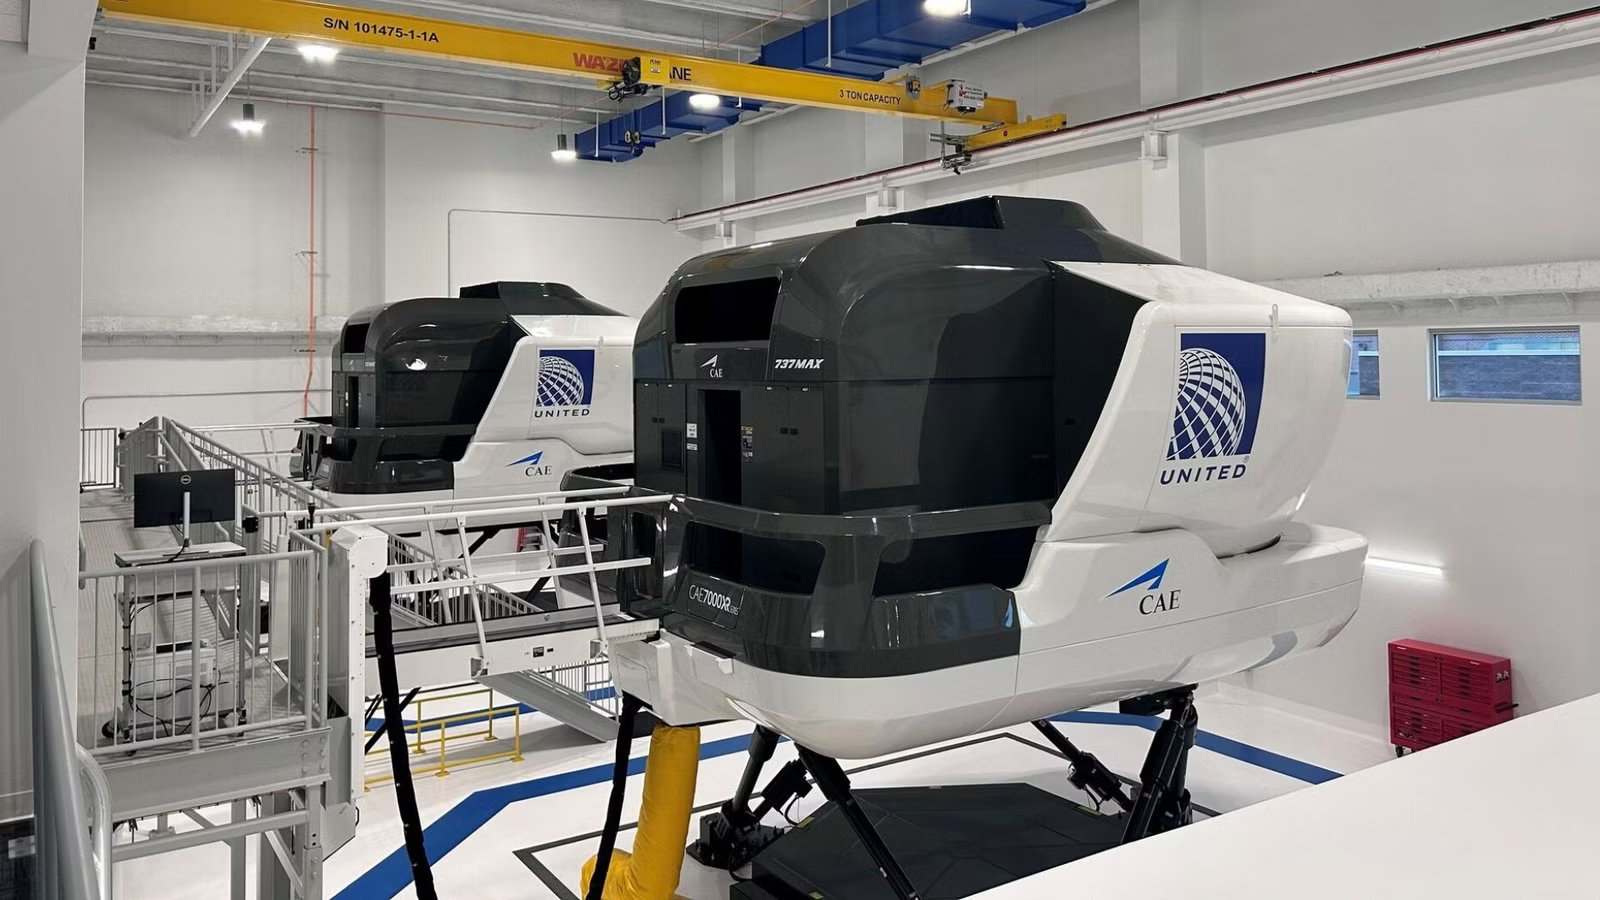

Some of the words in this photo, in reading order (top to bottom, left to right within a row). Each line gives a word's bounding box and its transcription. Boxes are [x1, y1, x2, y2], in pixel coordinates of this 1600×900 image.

[324, 17, 349, 30] S/N
[354, 22, 439, 43] 101475-1-1A
[669, 66, 692, 81] NE
[839, 89, 845, 98] 3
[846, 90, 862, 100] TON
[863, 93, 901, 105] CAPACITY
[775, 359, 824, 369] 737MAX
[709, 368, 723, 378] CAE
[534, 408, 590, 418] UNITED
[525, 465, 552, 477] CAE
[1160, 463, 1246, 485] UNITED
[1139, 590, 1181, 615] CAE
